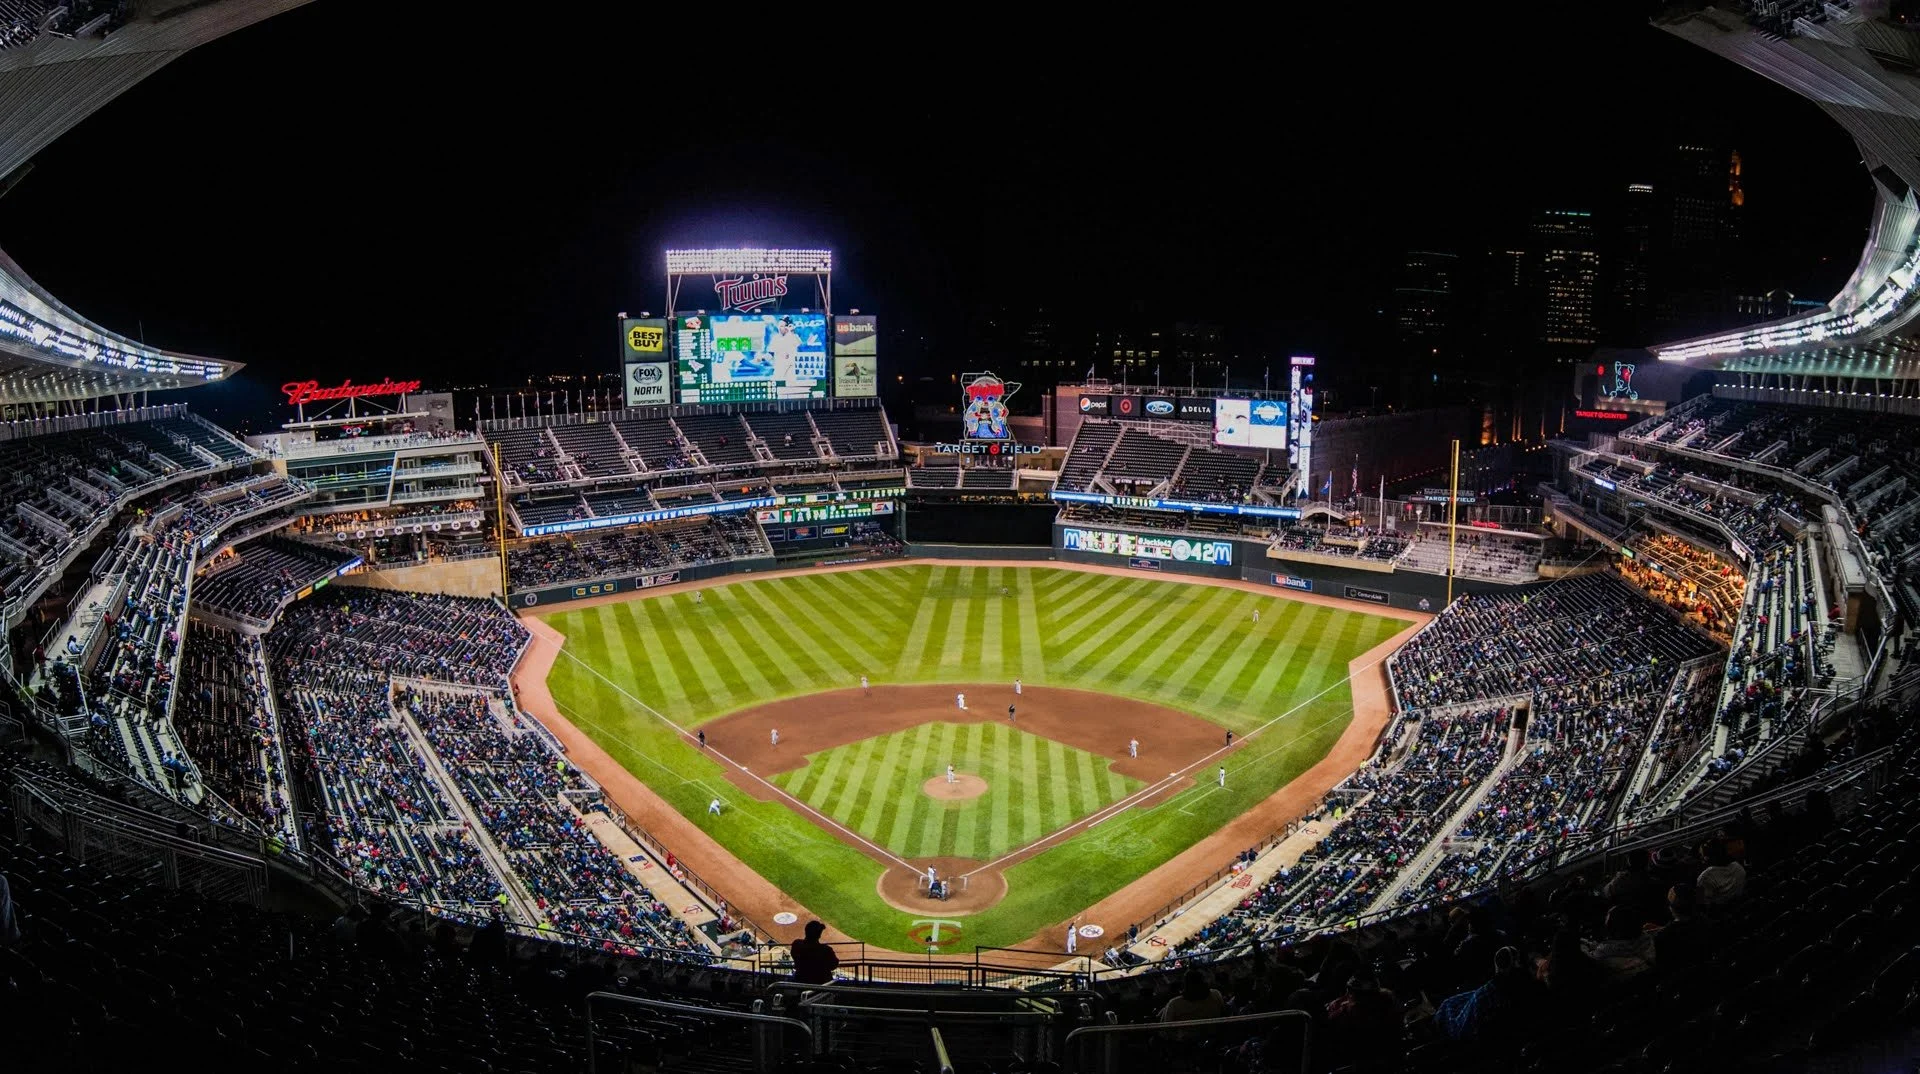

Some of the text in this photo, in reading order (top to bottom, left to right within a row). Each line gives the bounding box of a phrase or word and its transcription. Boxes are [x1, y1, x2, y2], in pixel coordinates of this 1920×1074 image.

[714, 273, 788, 311] Twins
[633, 331, 662, 340] BEST
[634, 340, 660, 348] BUY
[639, 368, 656, 377] FOX
[282, 378, 420, 404] Budweiser
[634, 386, 662, 396] NORTH
[1151, 402, 1168, 412] Ford
[935, 445, 1042, 454] TARGET FIELD
[823, 526, 848, 534] SUBWAY
[1190, 542, 1214, 562] 42
